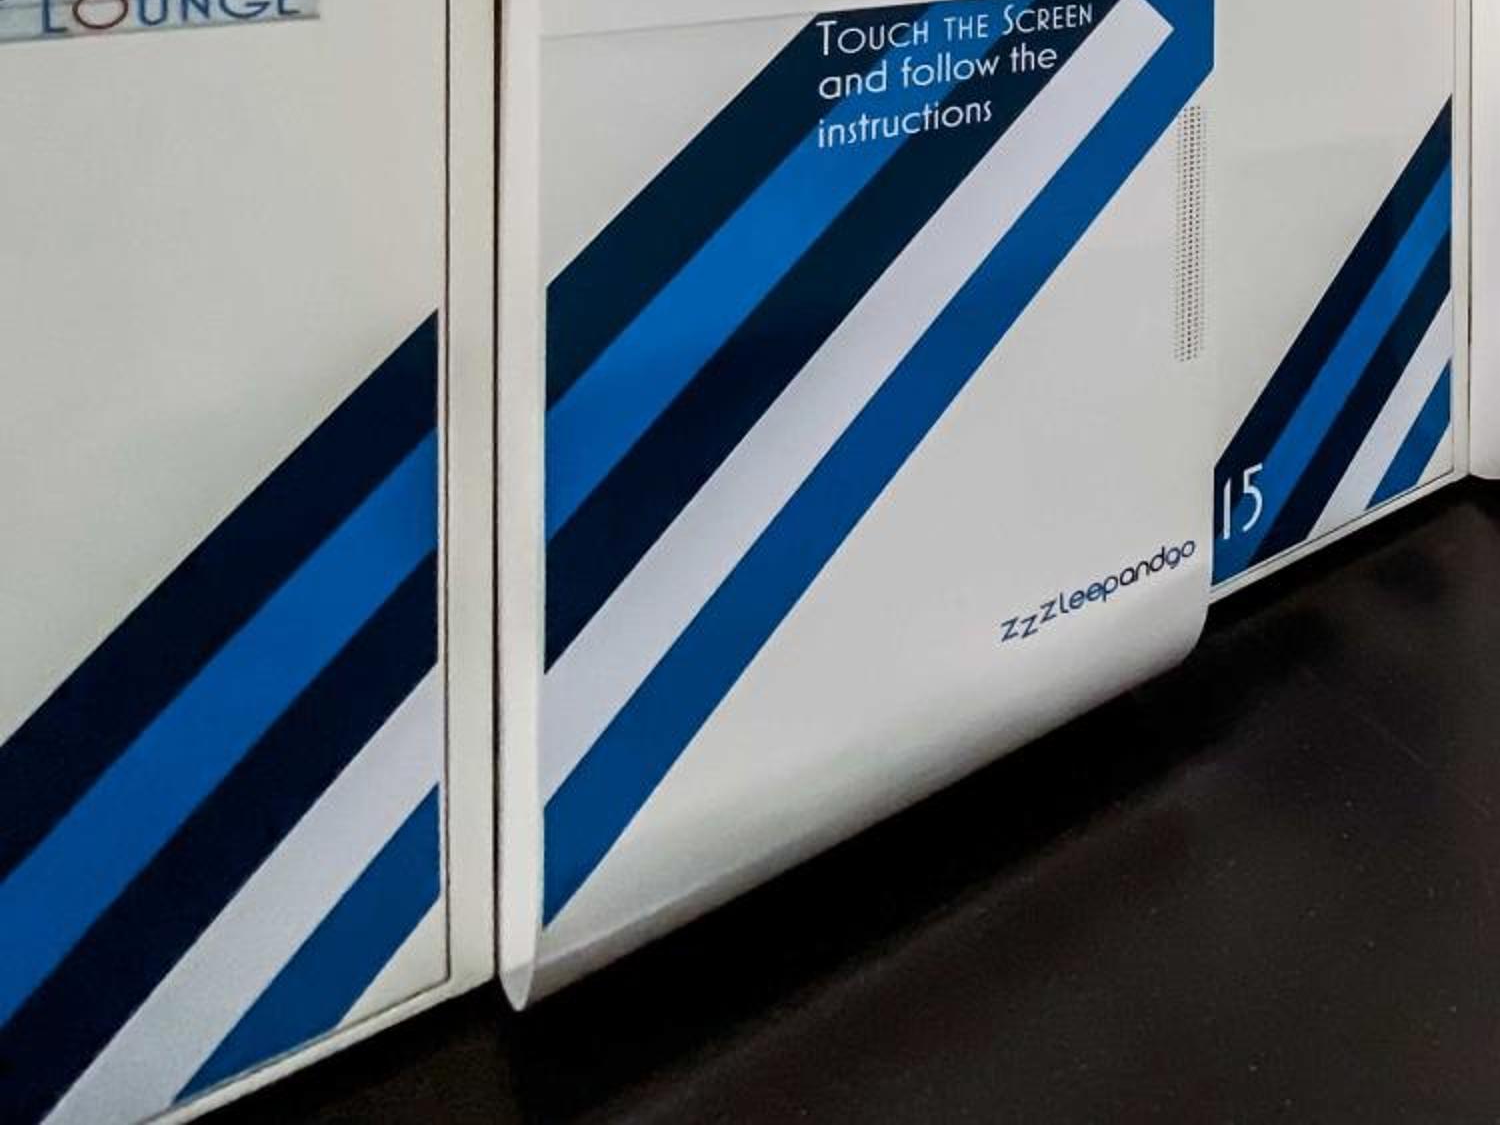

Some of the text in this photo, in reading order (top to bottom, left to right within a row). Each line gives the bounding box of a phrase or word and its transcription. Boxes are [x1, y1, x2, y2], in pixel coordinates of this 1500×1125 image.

[816, 3, 1093, 56] TOUCH THE SCREEN
[818, 42, 1058, 100] and follow the
[817, 99, 993, 148] instructions
[1223, 462, 1263, 540] 15
